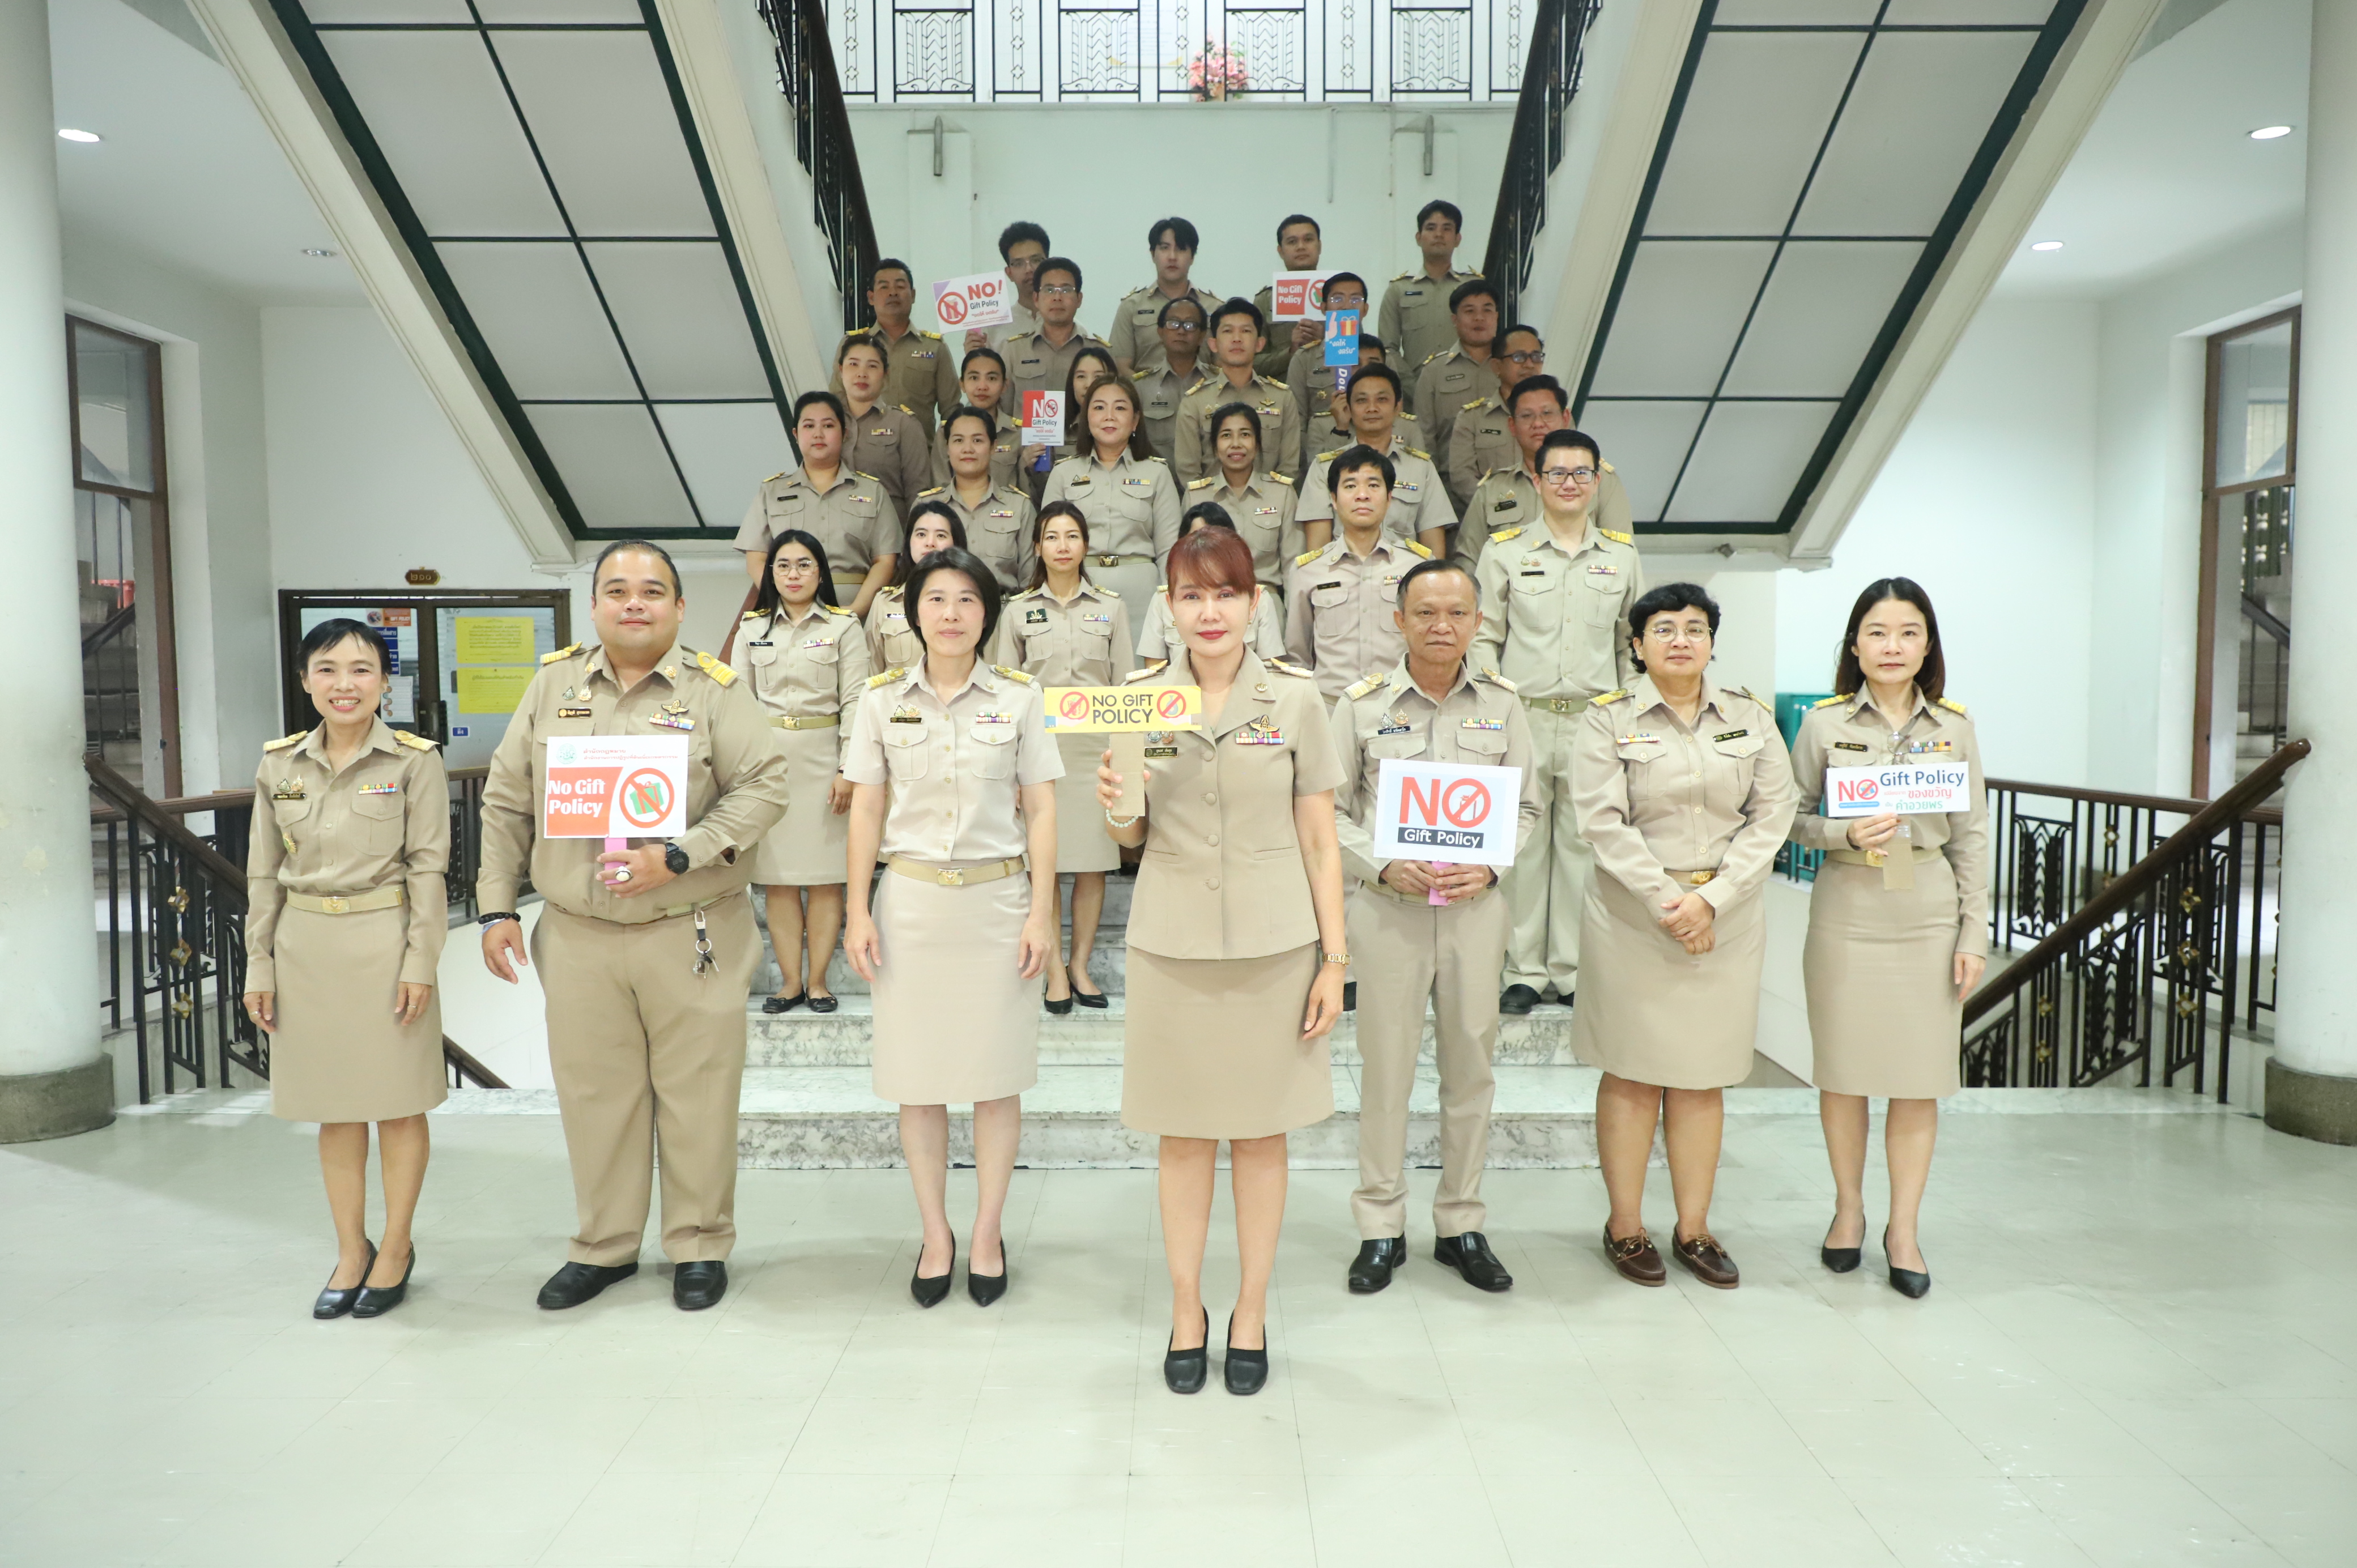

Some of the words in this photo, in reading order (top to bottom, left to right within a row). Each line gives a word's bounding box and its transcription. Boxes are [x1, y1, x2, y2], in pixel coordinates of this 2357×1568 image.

[1289, 285, 1302, 293] Gift
[981, 300, 999, 309] Policy
[1279, 295, 1301, 305] Policy
[1092, 694, 1117, 706] NO
[1122, 694, 1153, 707] GIFT
[1092, 709, 1153, 724] POLICY
[1880, 771, 1910, 787] Gift
[1916, 770, 1965, 786] Policy
[548, 780, 572, 795] No
[575, 778, 606, 795] Gift
[1908, 787, 1952, 799] ของขวัญ
[548, 798, 603, 817] Policy
[1896, 799, 1943, 811] คำอวยพร
[1404, 829, 1432, 843] Gift
[1437, 831, 1480, 848] Policy
